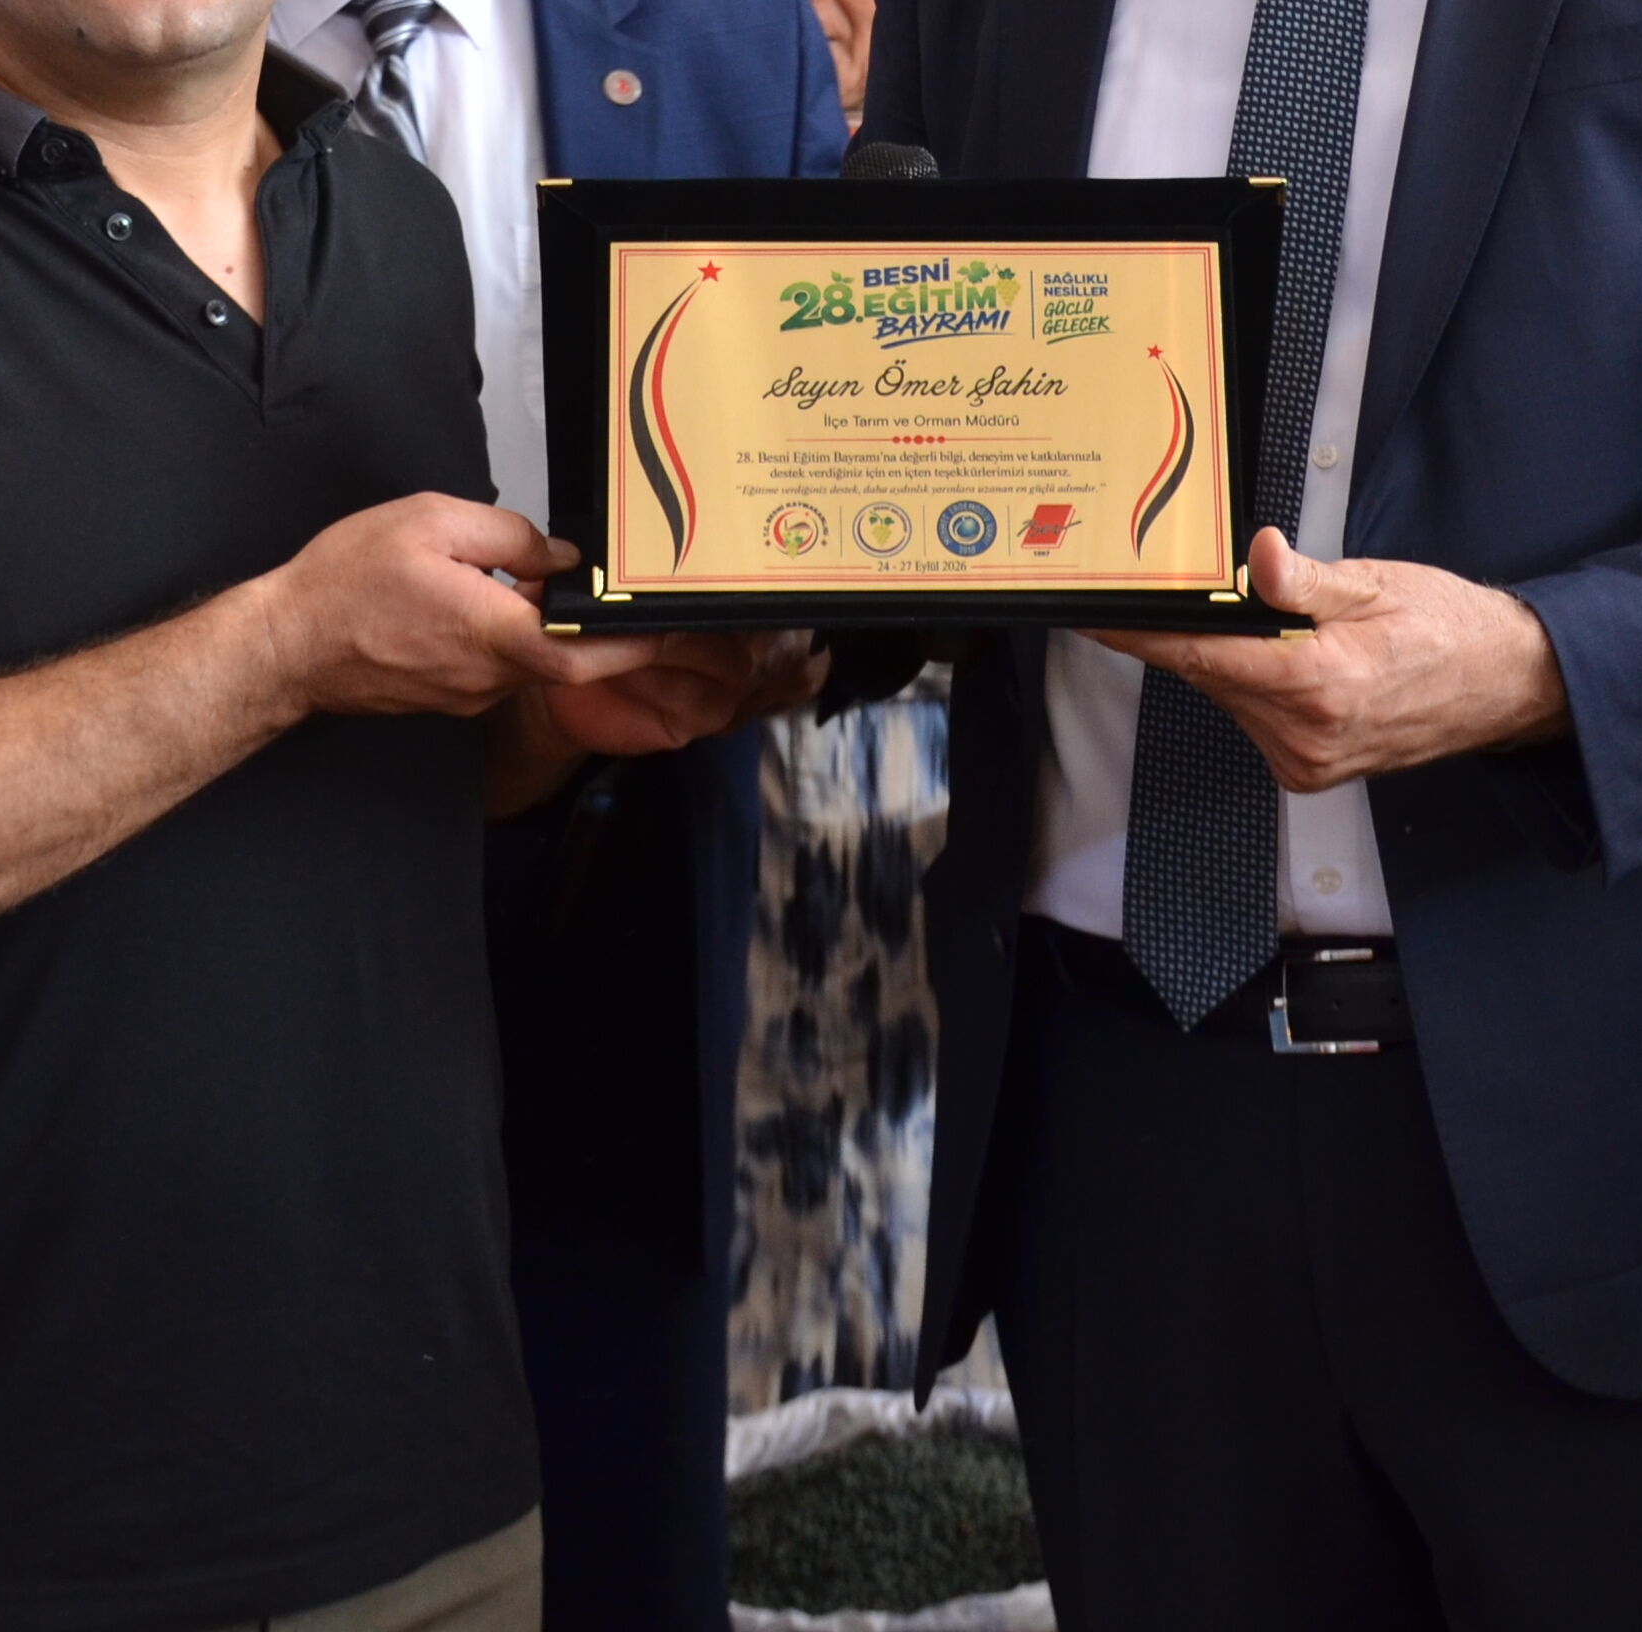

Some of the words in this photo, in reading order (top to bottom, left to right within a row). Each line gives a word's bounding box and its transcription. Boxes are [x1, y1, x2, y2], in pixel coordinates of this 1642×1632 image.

[863, 257, 950, 288] BESNİ
[1043, 272, 1108, 284] SAĞLIKLI
[1043, 284, 1108, 297] NESİLLER
[863, 281, 997, 317] EĞİTİM
[873, 309, 1011, 339] BAYRAMI
[1042, 315, 1110, 336] GELECEK
[762, 365, 865, 410] Sayın
[874, 359, 963, 397] Ömer
[965, 364, 1069, 408] Şahin
[823, 413, 849, 429] İlçe
[852, 415, 889, 428] Tarım
[893, 417, 910, 428] ve
[913, 414, 961, 428] Orman
[965, 414, 1020, 428] Müdürü
[735, 452, 755, 463] 28.
[758, 451, 790, 463] Besni
[793, 451, 830, 465] Eğitim
[899, 451, 937, 465] değerli
[968, 451, 1014, 465] deneyim
[1016, 453, 1029, 462] ve
[1030, 450, 1102, 462] katkılarınızla
[770, 468, 805, 479] destek
[808, 467, 863, 481] verdiğiniz
[865, 467, 886, 480] için
[888, 469, 902, 478] en
[904, 467, 932, 480] içten
[934, 466, 1025, 480] teşekkürlerimizi
[1015, 486, 1028, 494] en
[877, 560, 890, 573] 24
[900, 560, 912, 573] 27
[915, 559, 940, 574] Eylül
